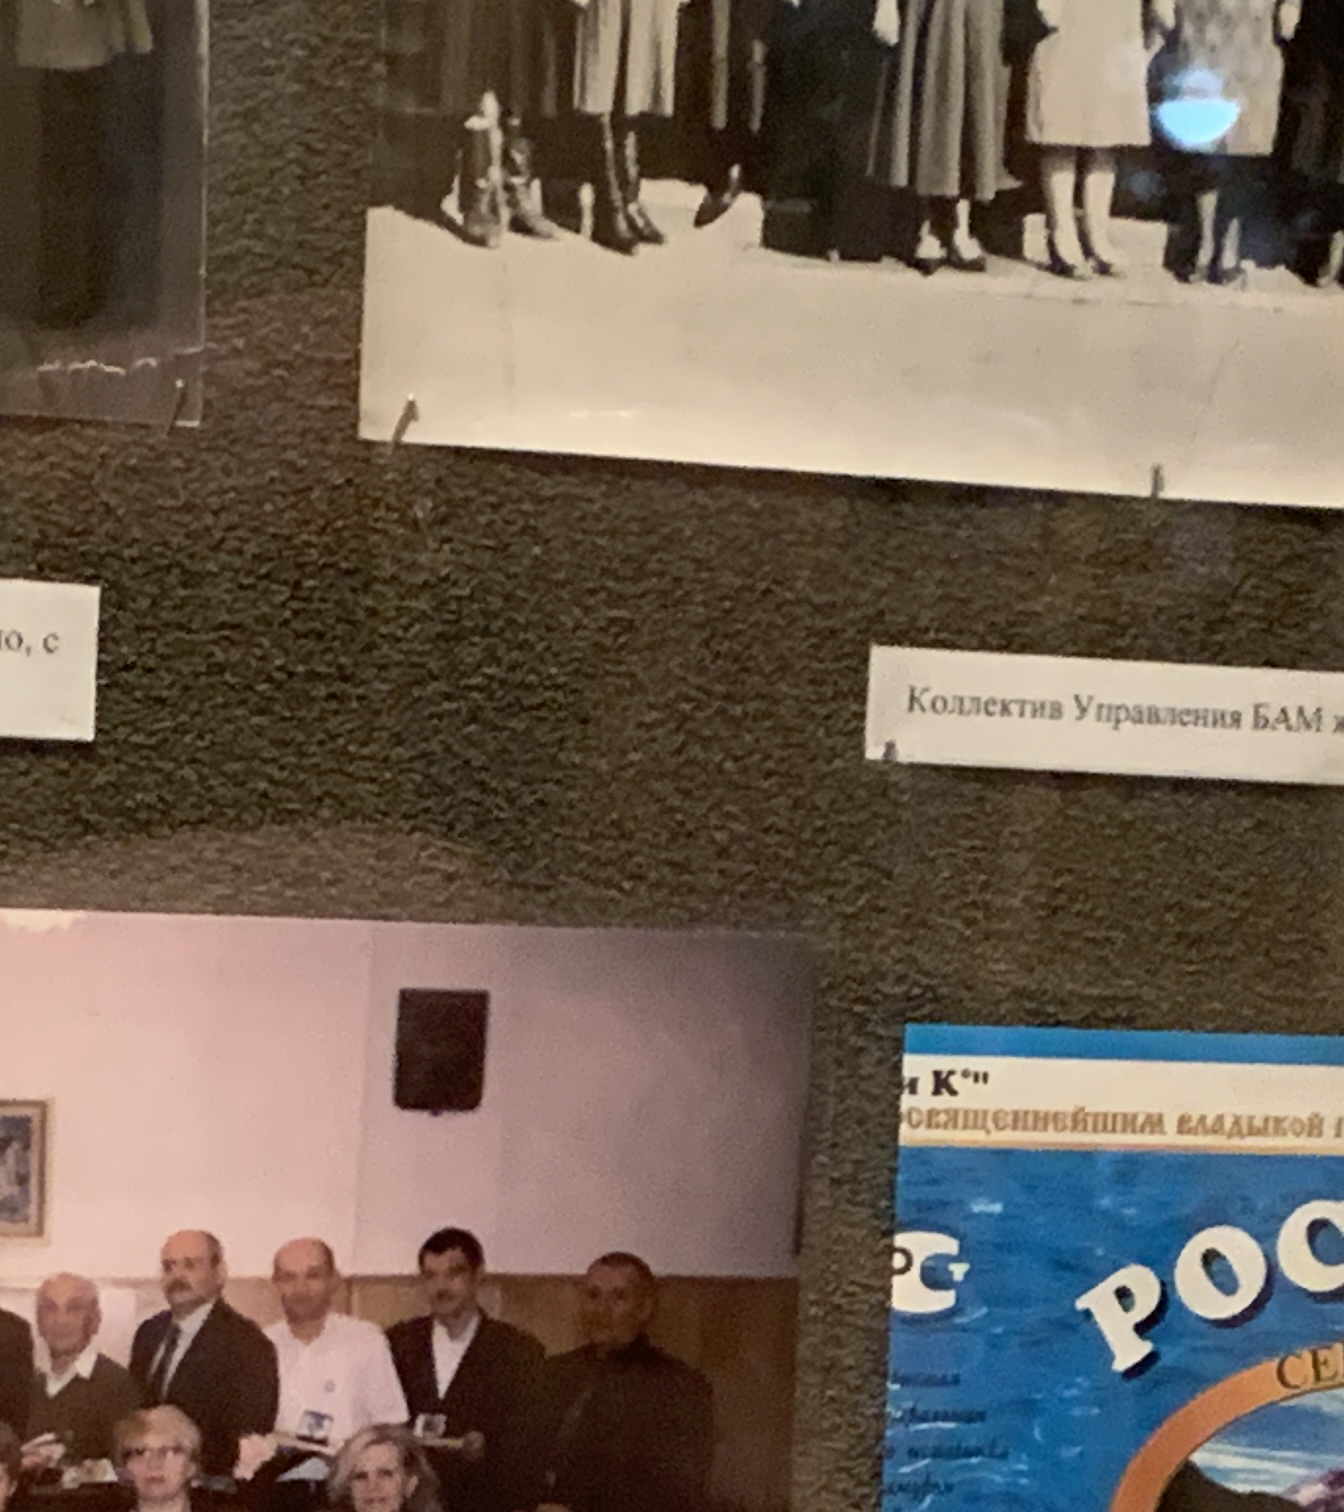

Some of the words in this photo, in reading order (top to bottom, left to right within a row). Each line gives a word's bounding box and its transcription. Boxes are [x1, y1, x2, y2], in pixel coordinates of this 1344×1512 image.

[42, 631, 60, 654] с
[906, 684, 1064, 722] Коллектив
[1072, 692, 1243, 731] Управления
[1251, 702, 1324, 734] БАМ
[902, 1105, 1167, 1137] СВЯЩЕННЕЙШИМ
